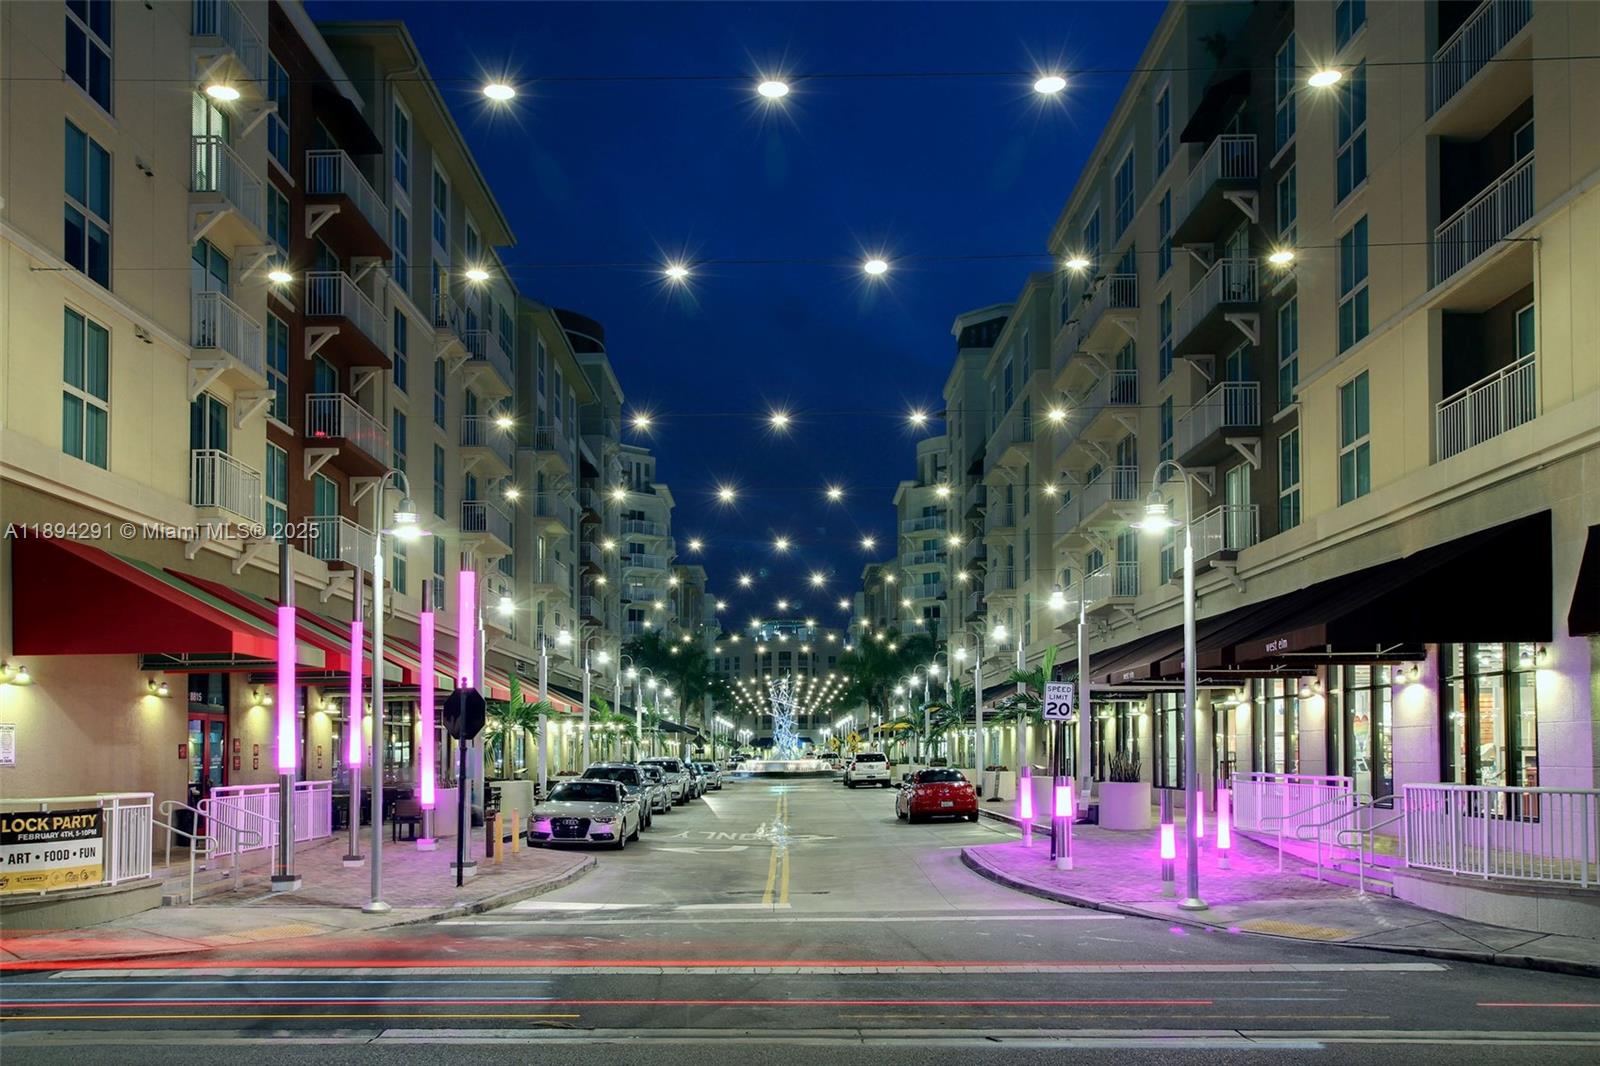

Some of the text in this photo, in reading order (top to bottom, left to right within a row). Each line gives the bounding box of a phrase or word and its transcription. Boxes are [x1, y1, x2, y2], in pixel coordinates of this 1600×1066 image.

[1046, 702, 1070, 716] 20
[1, 814, 97, 833] LOCK PARTY
[18, 832, 60, 840] FEBRUARY
[60, 830, 75, 838] 4TH,
[8, 846, 96, 865] ART FOOD FUN
